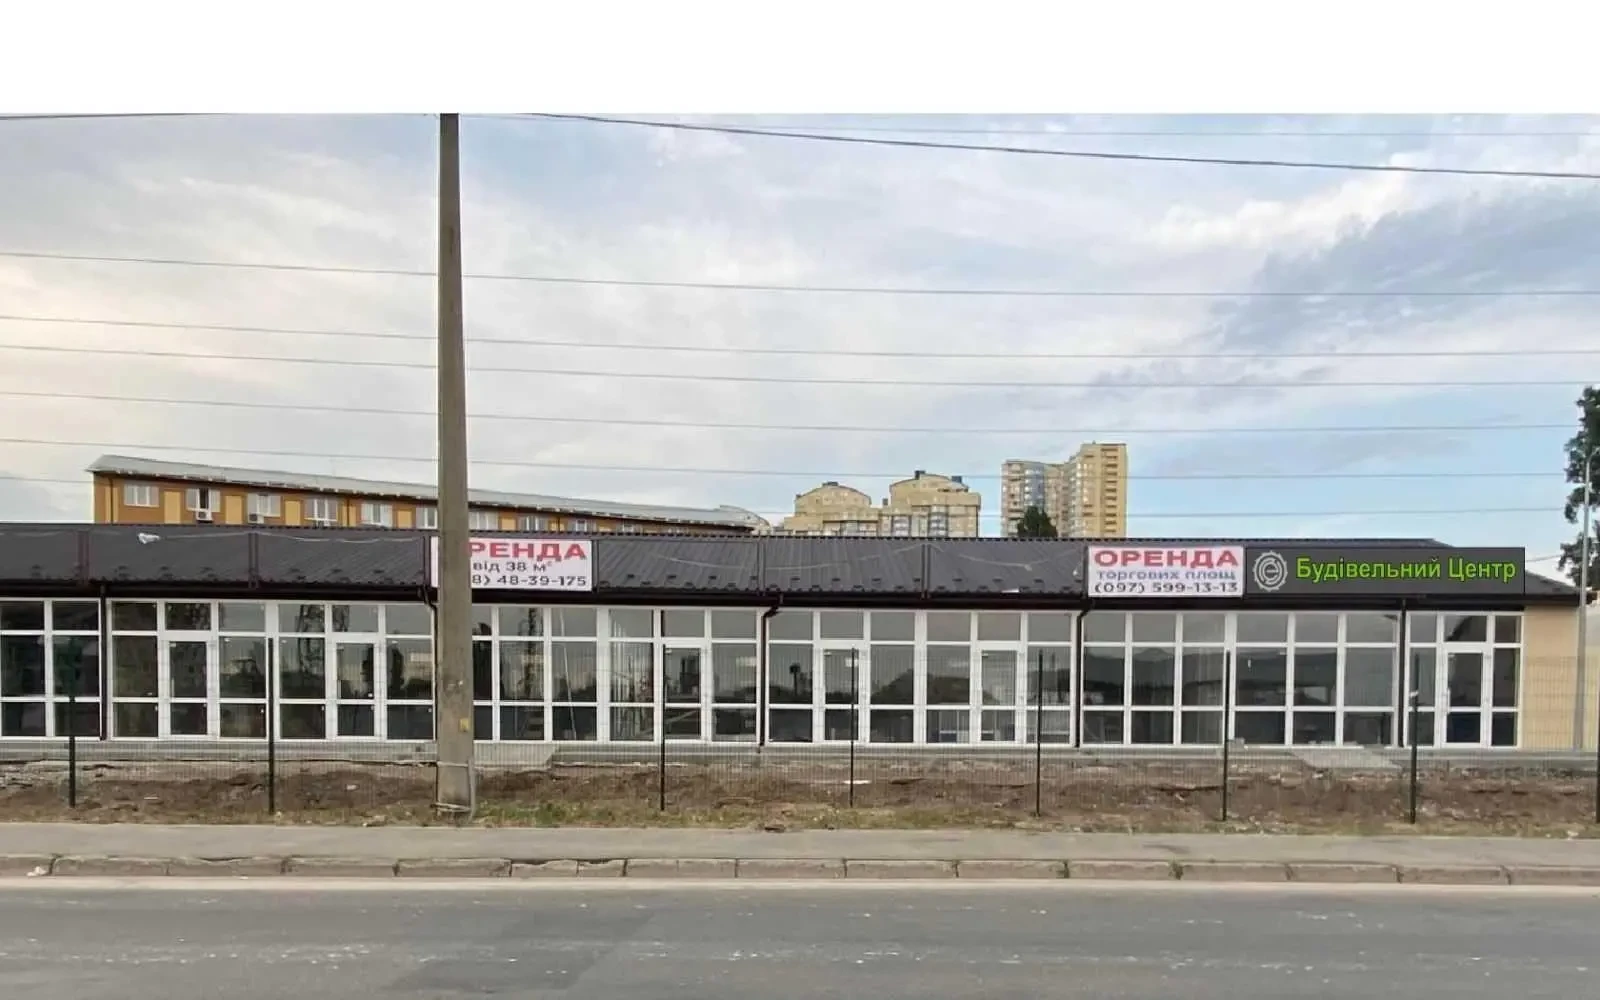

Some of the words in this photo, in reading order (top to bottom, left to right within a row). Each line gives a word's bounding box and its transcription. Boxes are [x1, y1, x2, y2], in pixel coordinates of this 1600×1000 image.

[468, 542, 586, 561] РЕНДА
[1094, 550, 1238, 568] ОРЕНДА
[473, 562, 500, 573] від
[506, 561, 527, 571] 38
[1296, 557, 1441, 583] Будівельний
[1448, 557, 1516, 582] Центр
[497, 575, 586, 586] 48-39-175
[1096, 570, 1180, 581] торгових
[1185, 570, 1235, 581] площ
[1095, 582, 1145, 594] (097)
[1152, 582, 1237, 593] 599-13-13
